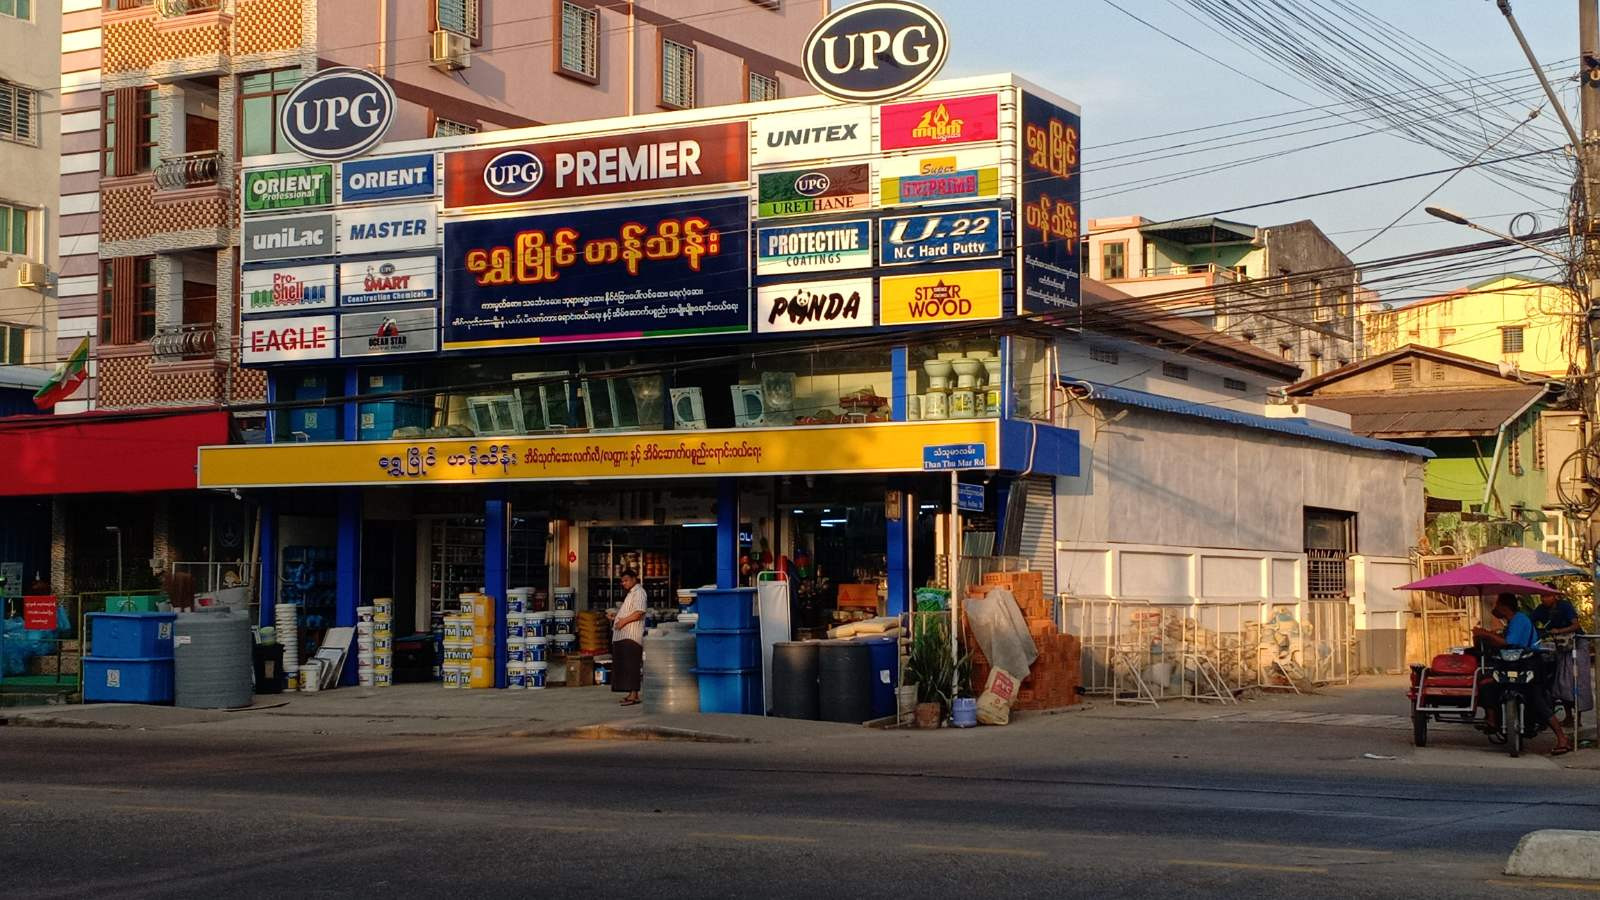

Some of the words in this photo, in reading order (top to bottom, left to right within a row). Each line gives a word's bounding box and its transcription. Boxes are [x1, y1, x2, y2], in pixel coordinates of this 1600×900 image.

[822, 25, 931, 74] UPG
[293, 92, 381, 135] UPG
[766, 123, 858, 148] UNITEX
[487, 162, 539, 186] UPG
[555, 139, 702, 189] PREMIER
[922, 163, 955, 175] Super
[253, 174, 323, 195] ORIENT
[349, 166, 427, 190] ORIENT
[798, 178, 827, 191] UPG
[262, 189, 315, 201] Professional
[773, 196, 855, 214] URETHANE
[253, 226, 324, 250] uniLac
[350, 219, 427, 241] MASTER
[768, 227, 860, 256] PROTECTIVE
[894, 246, 914, 260] N.C
[919, 243, 947, 258] Hard
[953, 241, 986, 257] Putty
[786, 251, 842, 268] COATINGS
[273, 281, 304, 300] Shell
[363, 275, 411, 292] SMART
[347, 293, 391, 303] Construction
[392, 290, 427, 300] Chemicals
[908, 299, 972, 318] WOOD
[251, 326, 326, 353] EAGLE
[925, 461, 942, 469] Than
[942, 460, 956, 468] Thu
[974, 458, 984, 466] Rd
